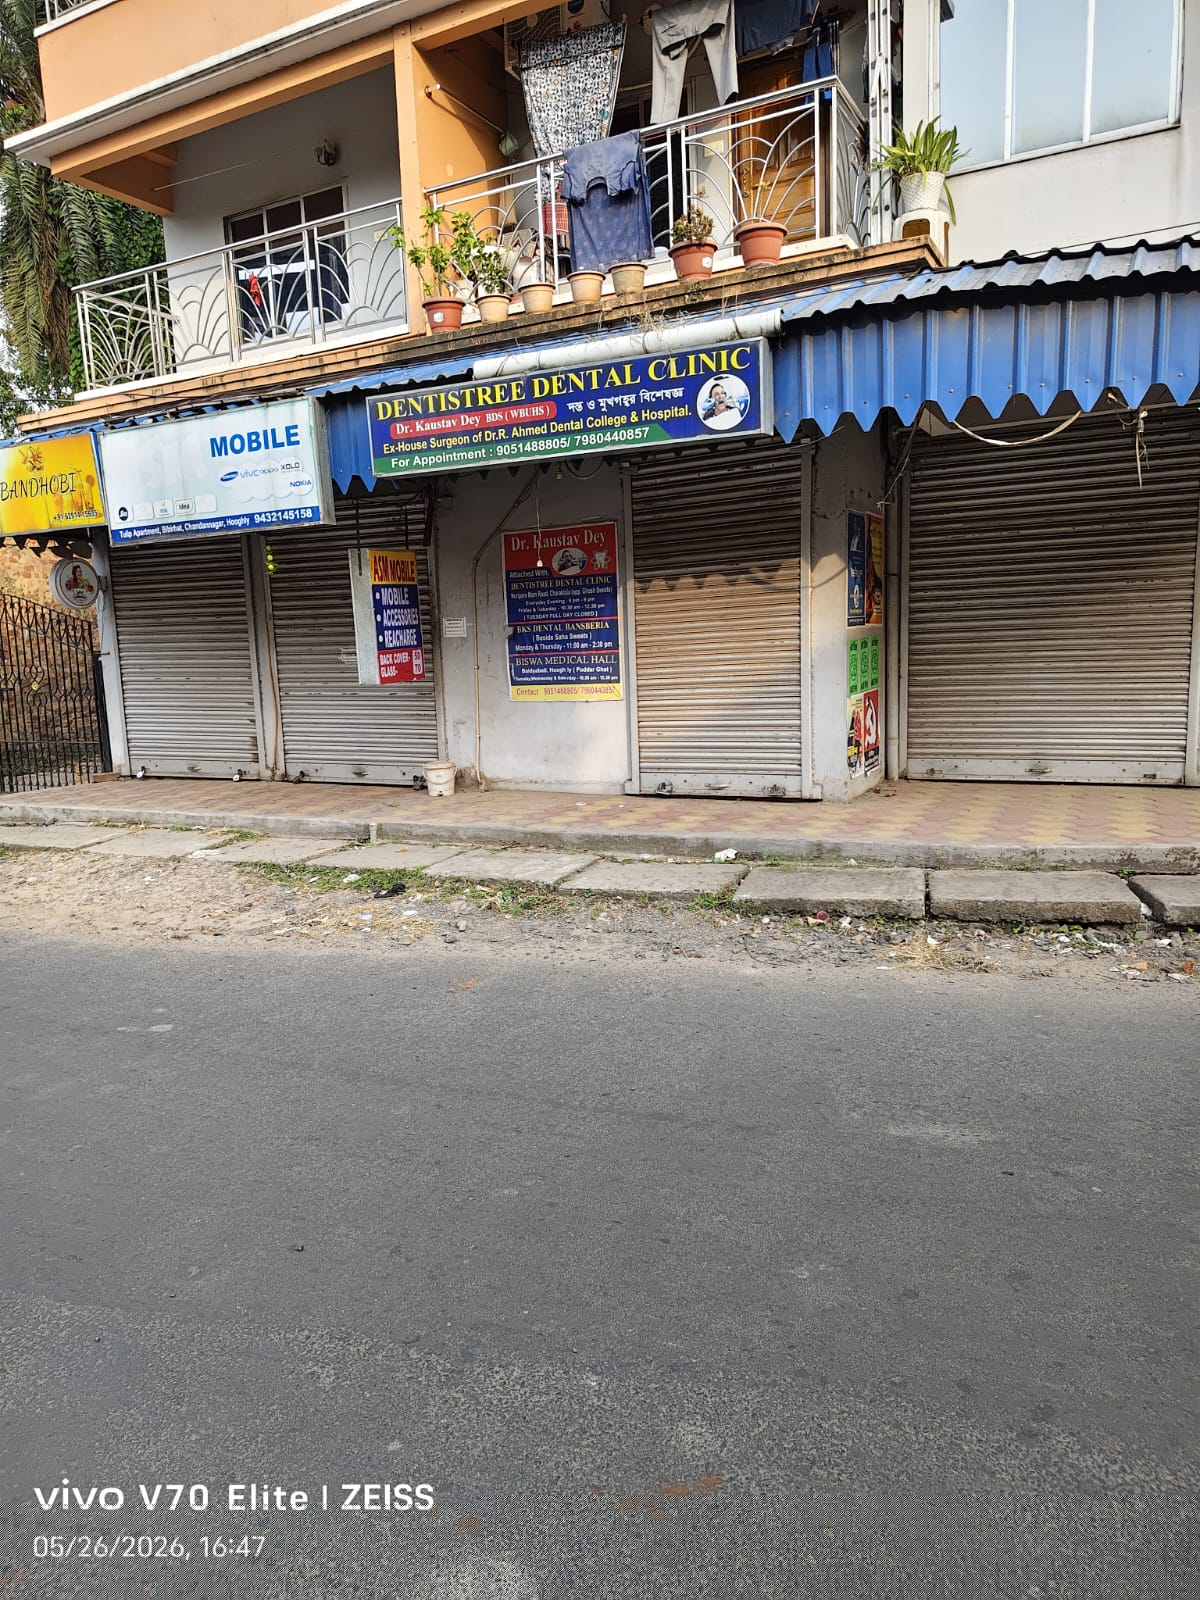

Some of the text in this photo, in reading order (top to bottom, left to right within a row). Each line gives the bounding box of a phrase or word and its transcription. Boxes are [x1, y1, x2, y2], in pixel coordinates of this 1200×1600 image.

[376, 347, 750, 420] DENTISTREE DENTAL CLINIC
[587, 400, 596, 410] ও
[383, 442, 428, 454] Ex-House
[430, 436, 470, 449] Surgeon
[472, 433, 483, 443] of
[512, 423, 548, 438] Ahmed
[550, 416, 583, 432] Dental
[586, 413, 626, 428] College
[630, 410, 639, 422] &
[642, 404, 692, 422] Hospital.
[396, 423, 412, 434] Dr.
[416, 417, 457, 432] Kaustav
[460, 414, 480, 429] Dey
[486, 412, 503, 422] BDS
[210, 424, 300, 458] MOBILE
[392, 458, 410, 468] For
[412, 448, 486, 468] Appointment
[496, 438, 571, 456] 9051488805/
[574, 427, 650, 446] 7980440857
[280, 462, 300, 470] XOLO
[0, 472, 76, 502] BANDHOBI
[290, 480, 312, 488] NOKIA
[120, 530, 132, 539] Tulip
[134, 526, 162, 537] Apartment,
[184, 520, 226, 531] Chandannagar,
[226, 516, 250, 528] Hooghly
[254, 508, 312, 524] 9432145158
[512, 530, 608, 551] Dr. Kaustav Dey
[374, 555, 415, 582] ASM MOBILE
[512, 576, 612, 590] DENTISTREE DENTAL CLINIC
[381, 588, 409, 606] MOBILE
[383, 608, 418, 627] ACCESSORIES
[533, 624, 563, 632] DENTAL
[566, 621, 610, 631] BANSBERIA
[384, 628, 417, 648] REACHARGE
[380, 654, 393, 666] BACK
[515, 655, 617, 666] BISWA MEDICAL HALL
[516, 688, 538, 696] Contact
